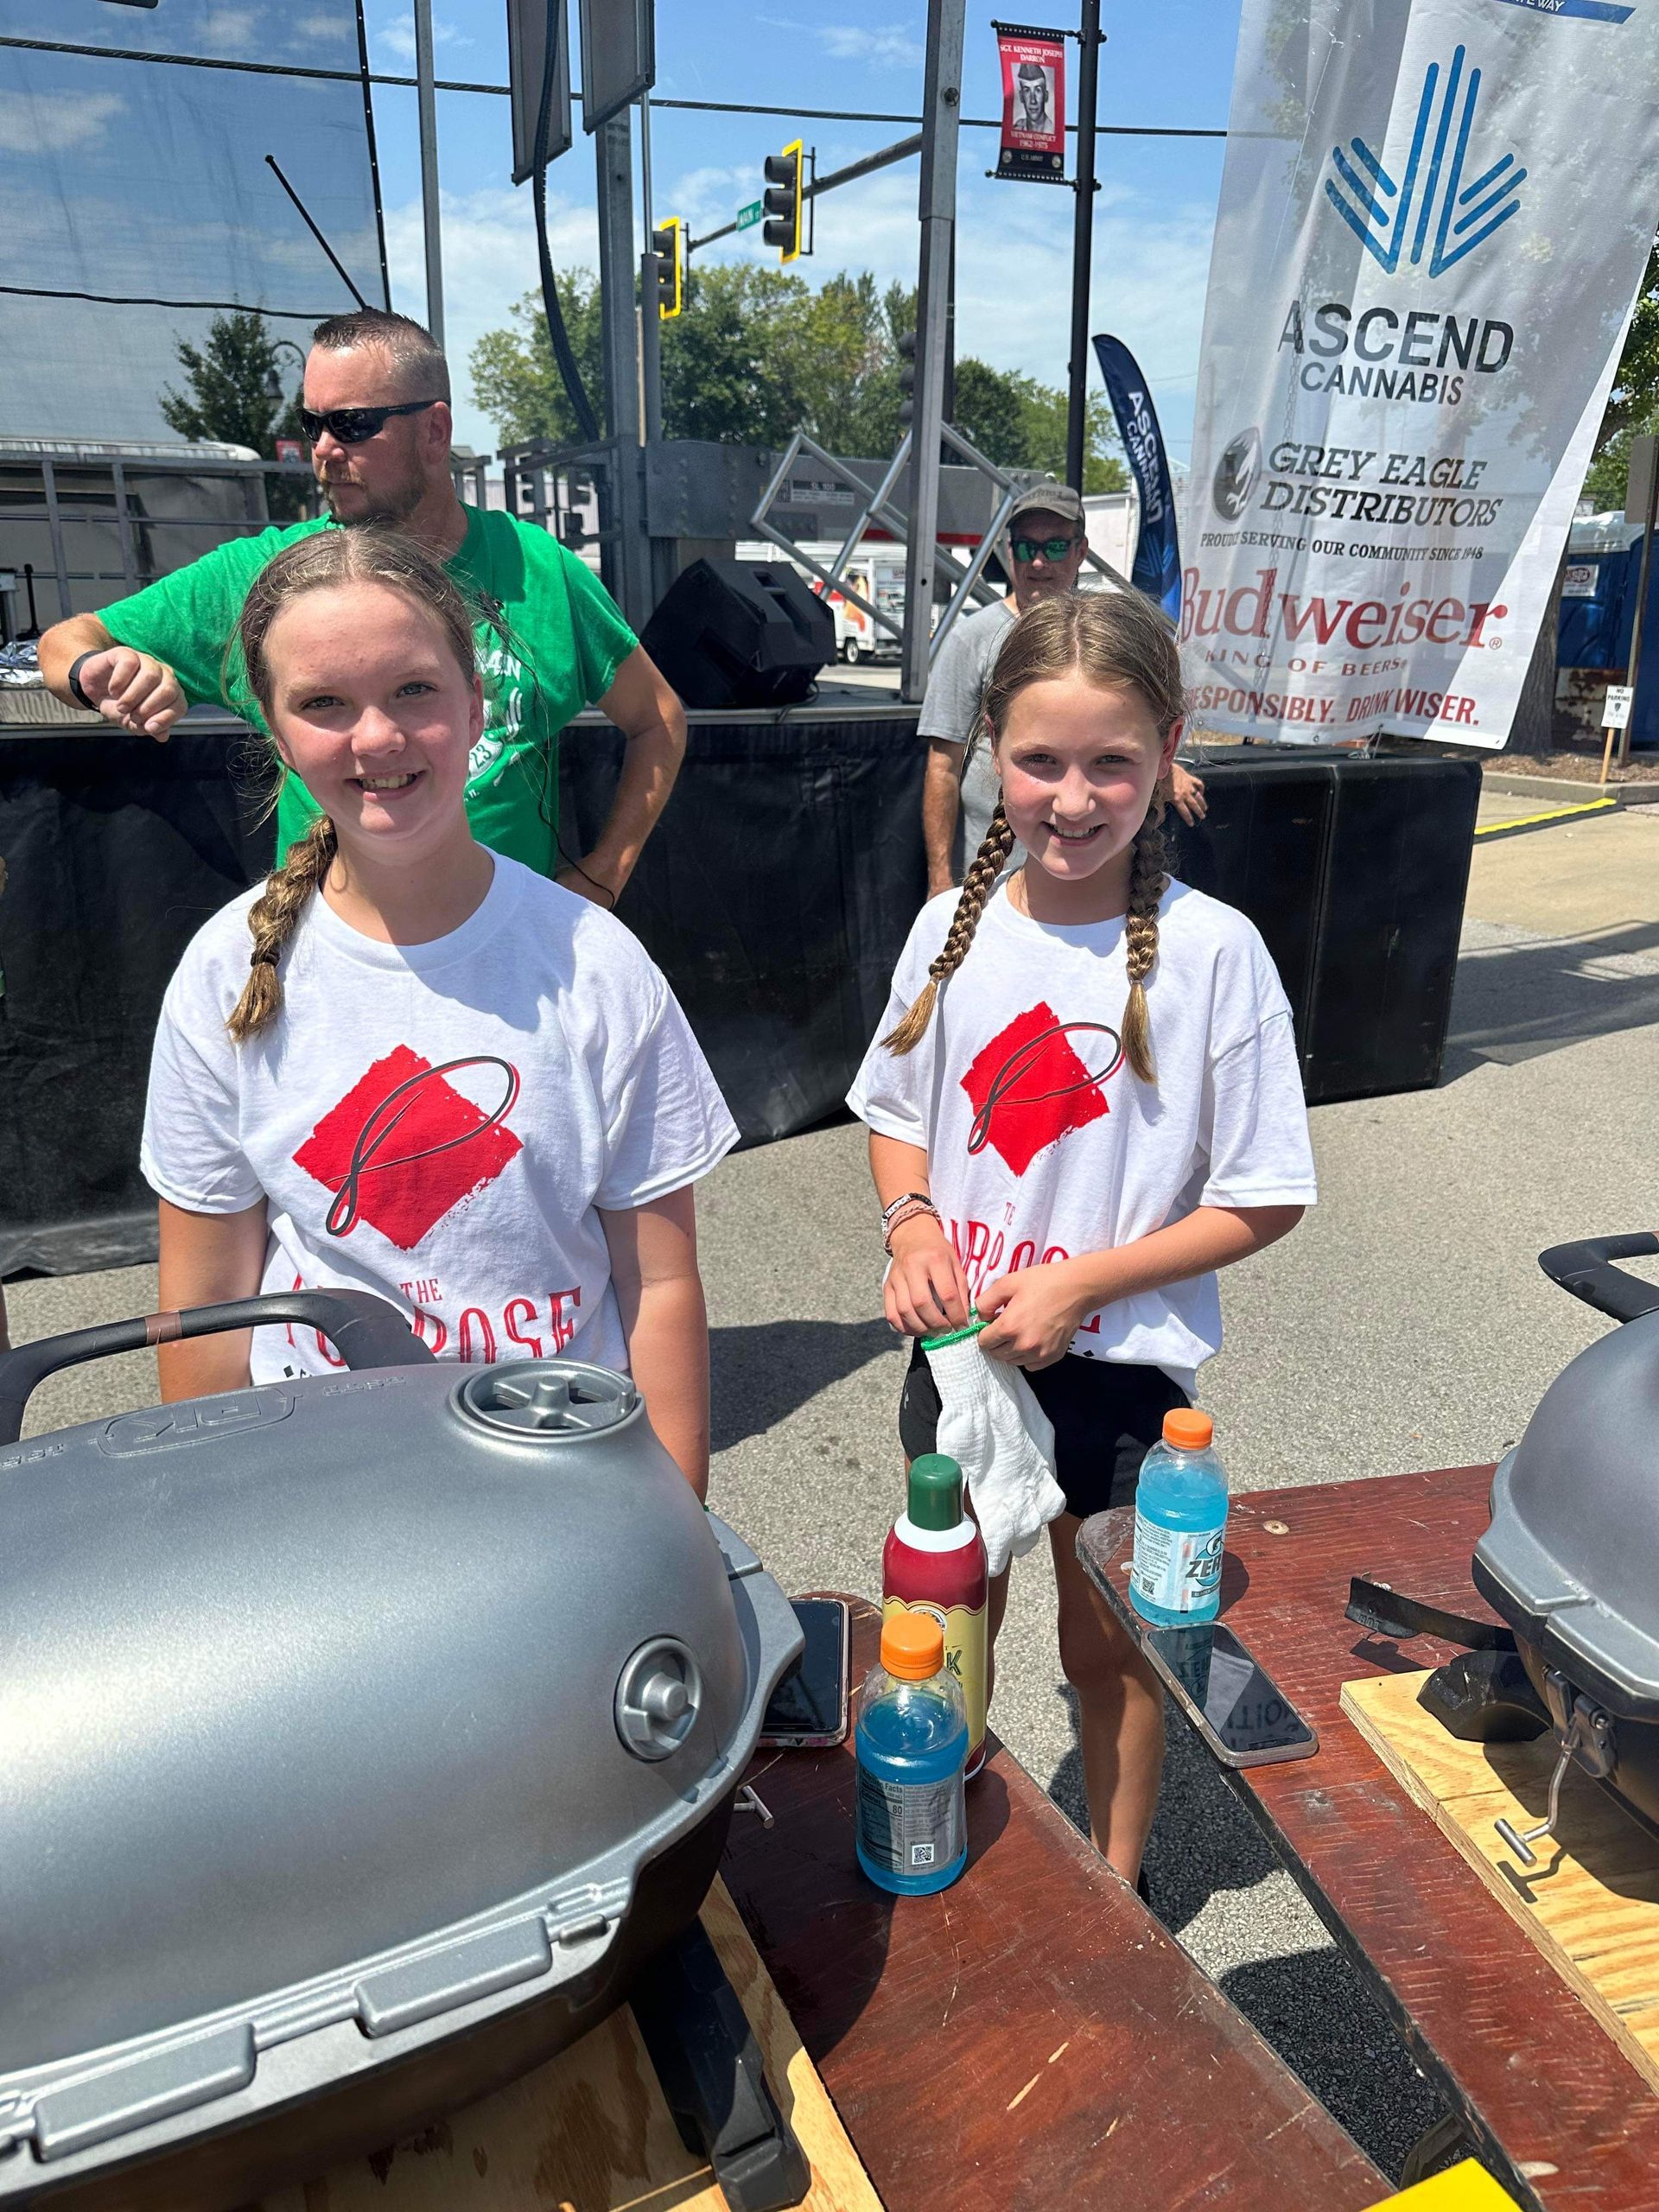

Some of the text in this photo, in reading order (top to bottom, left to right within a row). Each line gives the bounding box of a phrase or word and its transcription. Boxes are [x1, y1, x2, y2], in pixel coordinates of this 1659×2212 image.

[1013, 45, 1041, 55] KENNETH
[1042, 48, 1064, 58] JOSEPH
[1011, 130, 1033, 140] VIETNAM
[1278, 300, 1515, 374] ASCEND
[1300, 360, 1465, 406] CANNABIS
[1268, 442, 1488, 491] GREY EAGLE
[1259, 480, 1503, 528] DISTRIBUTORS
[1240, 531, 1307, 552] SERVING
[1312, 539, 1345, 556] OUR
[1349, 543, 1429, 562] COMMUNITY
[1428, 547, 1463, 561] SINCE
[1205, 649, 1402, 677] KING OF BEERS
[1346, 690, 1394, 722] DRINK
[1394, 688, 1480, 726] WISER.
[400, 1278, 443, 1304] THE
[884, 1783, 903, 1794] Facts
[892, 1805, 903, 1815] 80
